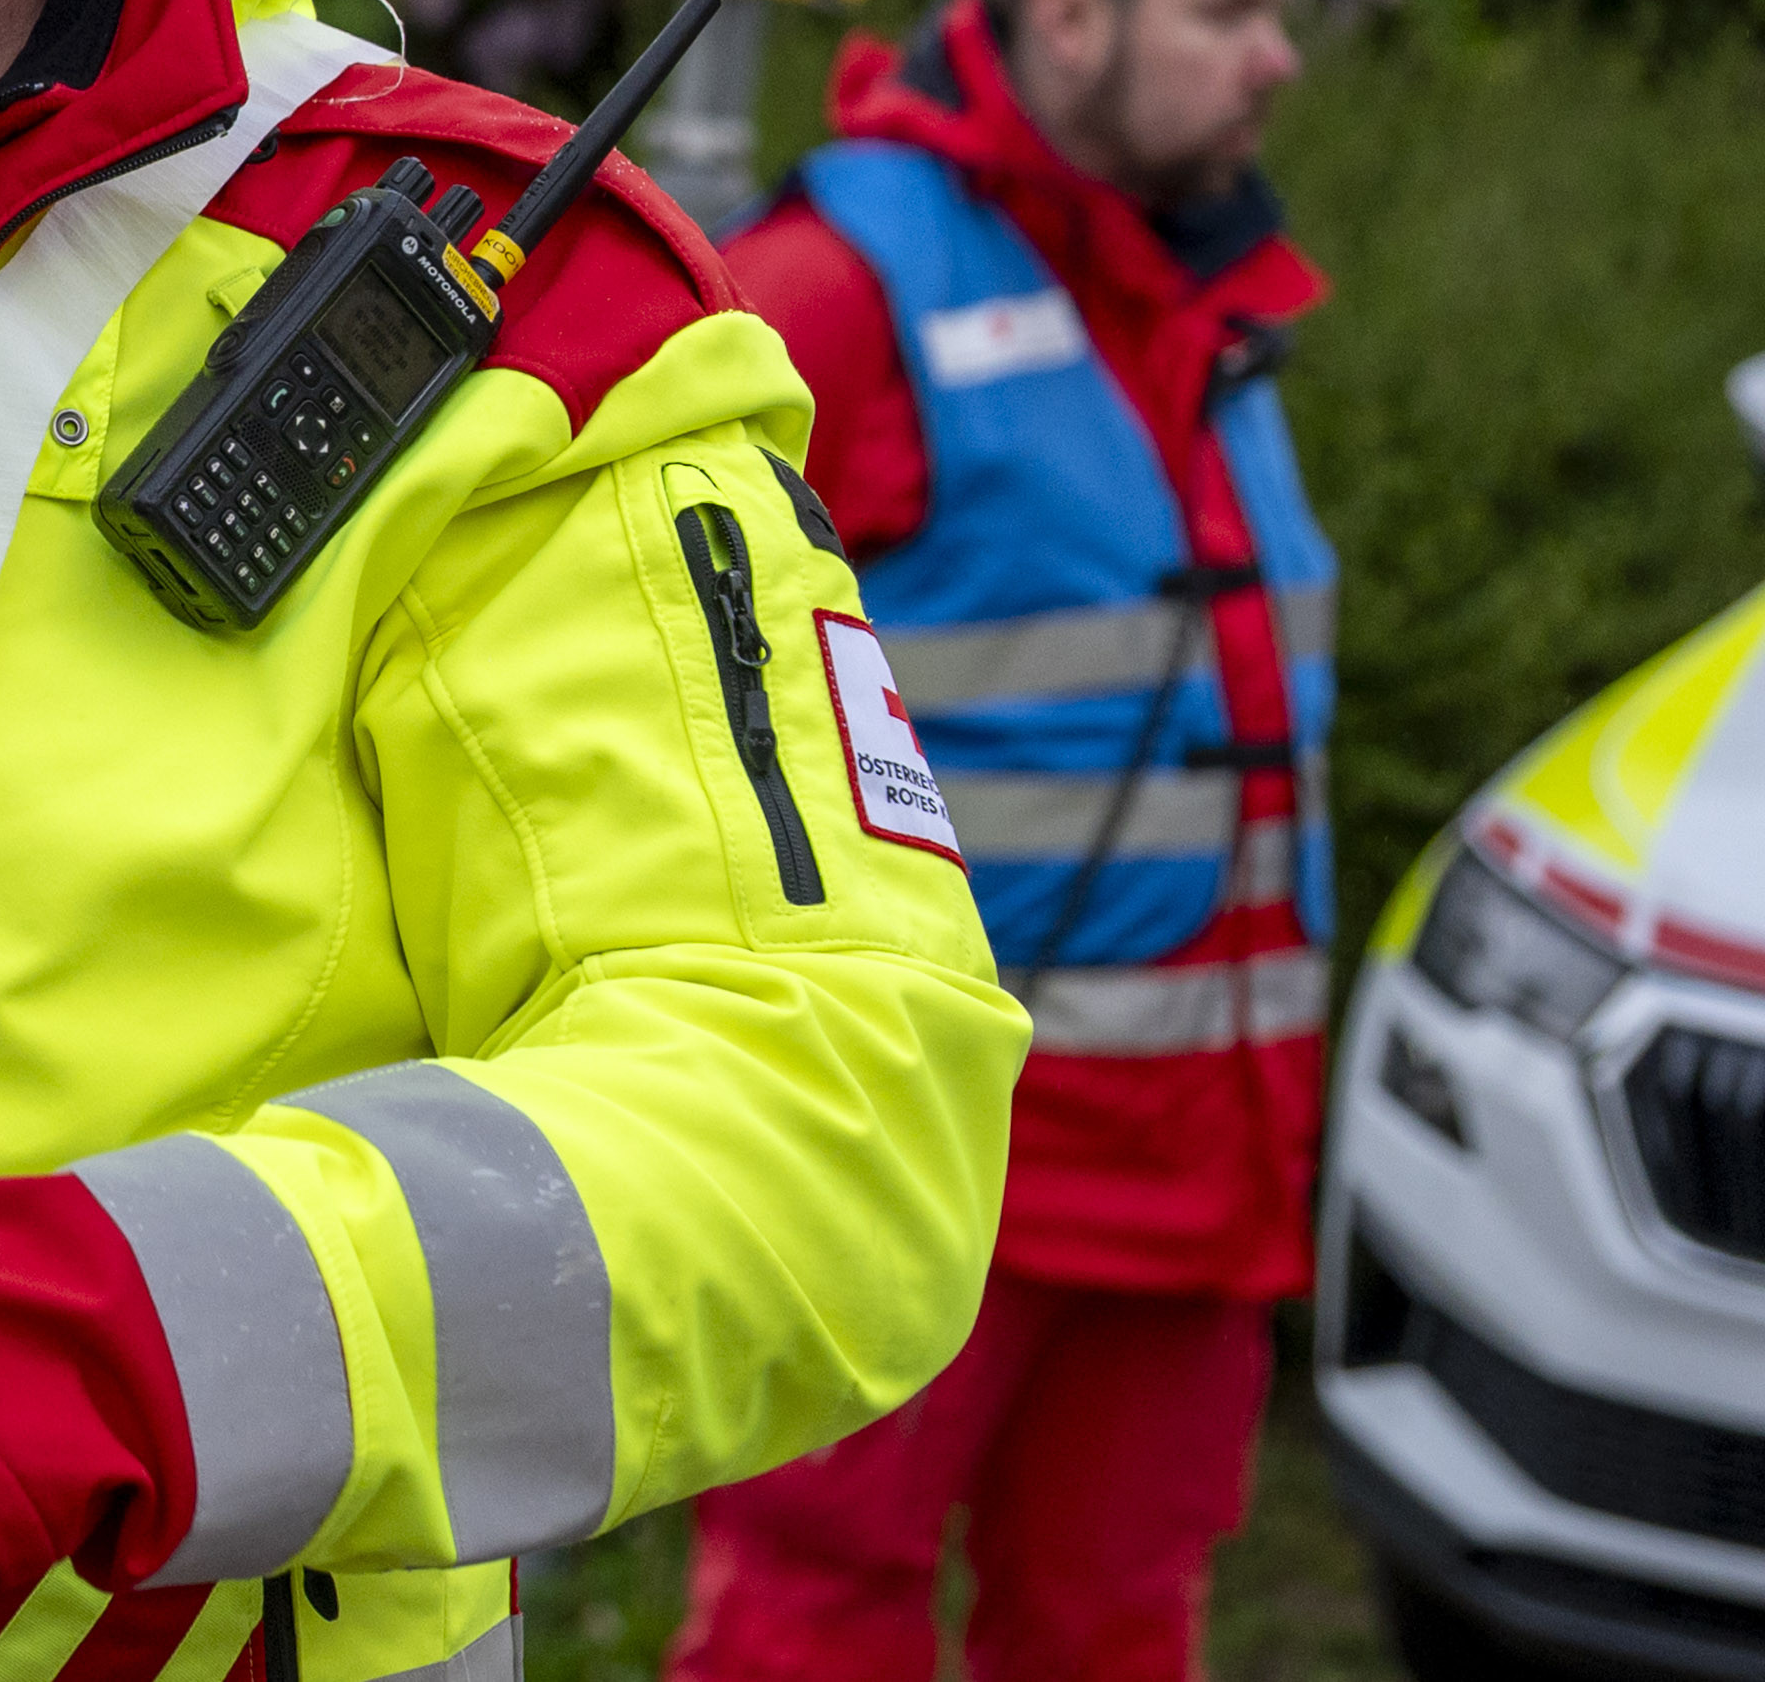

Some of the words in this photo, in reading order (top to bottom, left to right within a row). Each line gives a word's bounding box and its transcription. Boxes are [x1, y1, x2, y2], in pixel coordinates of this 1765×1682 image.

[417, 256, 477, 324] MOTOROLA
[227, 442, 236, 454] 1
[210, 461, 221, 473] 4
[193, 479, 205, 491] 7
[257, 475, 268, 488] 2
[241, 493, 252, 507] 5
[225, 513, 236, 525] 8
[285, 507, 296, 520] 3
[209, 532, 220, 545] 0
[269, 527, 280, 540] 6
[253, 545, 264, 558] 9
[885, 785, 938, 815] ROTES
